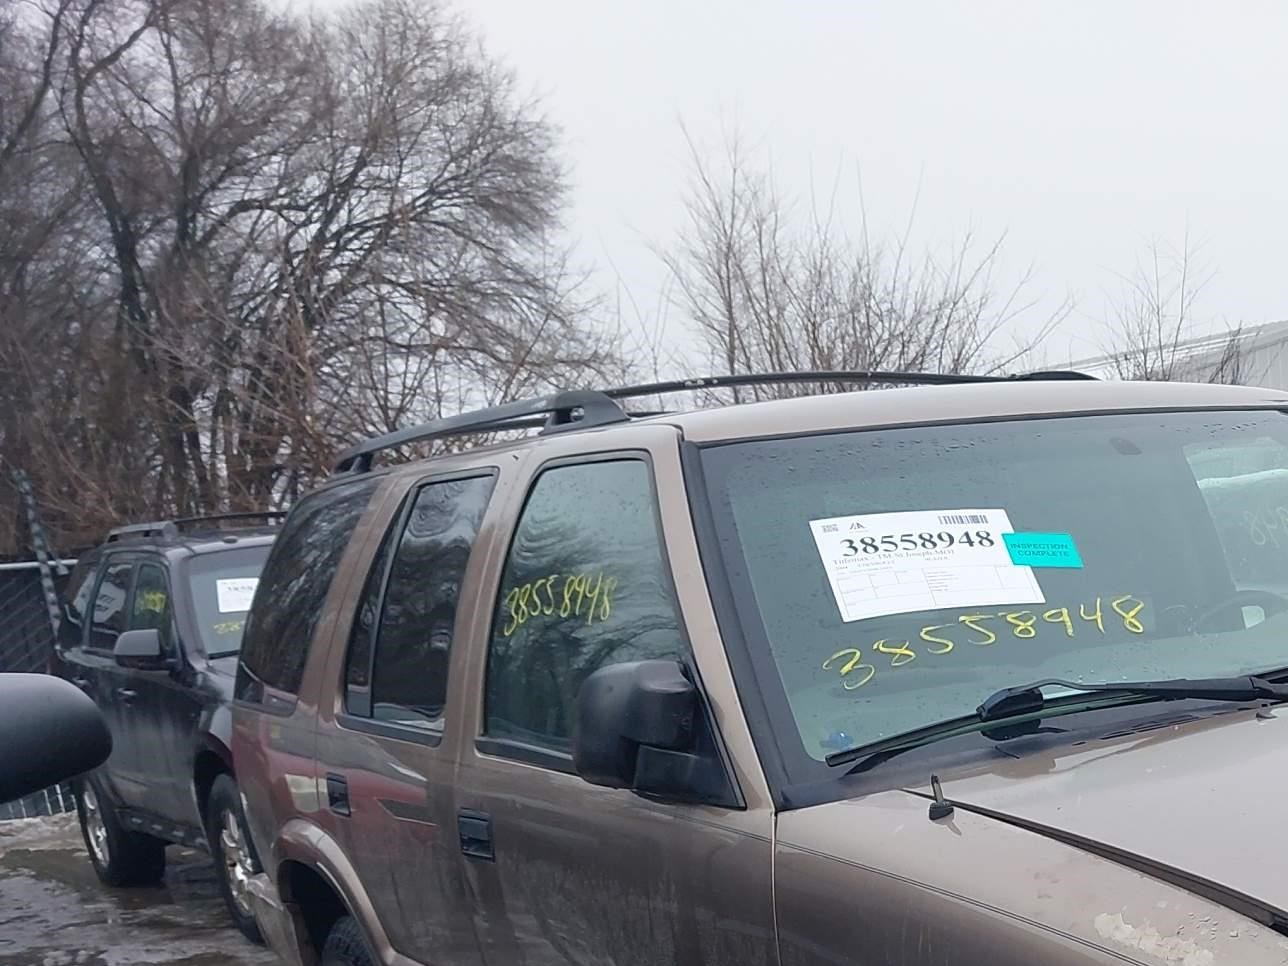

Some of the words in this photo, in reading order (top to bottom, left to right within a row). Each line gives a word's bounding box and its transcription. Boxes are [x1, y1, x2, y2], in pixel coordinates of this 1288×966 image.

[840, 530, 995, 557] 38558948
[504, 571, 618, 636] 38558948
[822, 595, 1145, 690] 38558948
